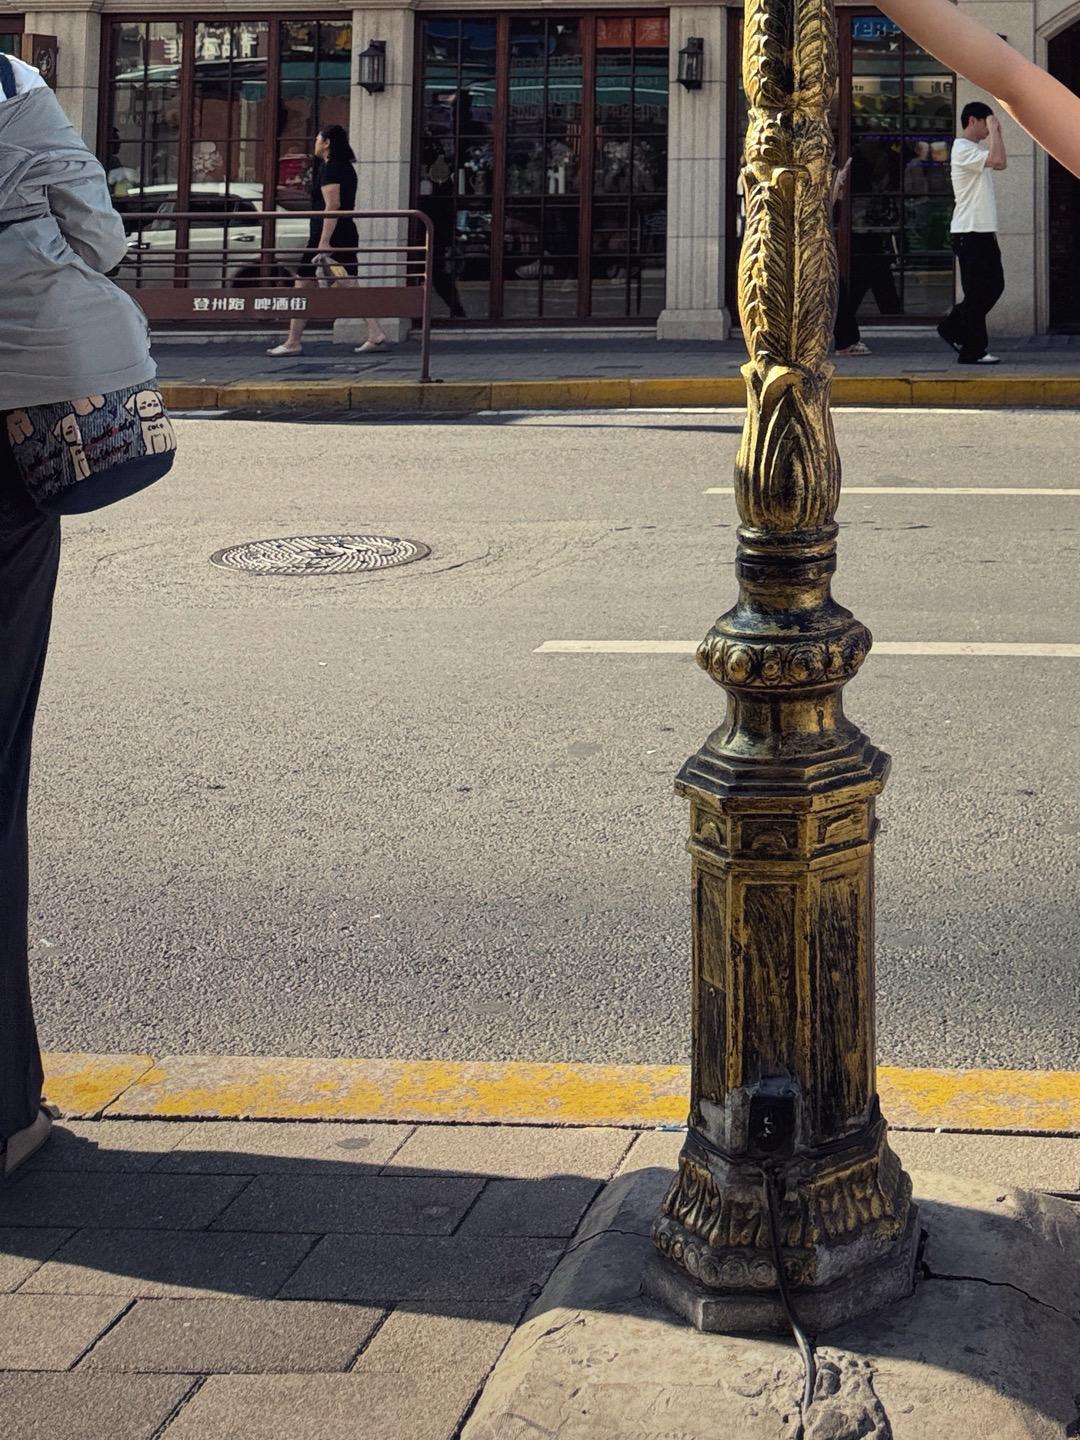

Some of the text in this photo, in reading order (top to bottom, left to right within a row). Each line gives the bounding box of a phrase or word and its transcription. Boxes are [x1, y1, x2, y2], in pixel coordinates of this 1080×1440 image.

[192, 297, 306, 311] 登州路 啤酒街
